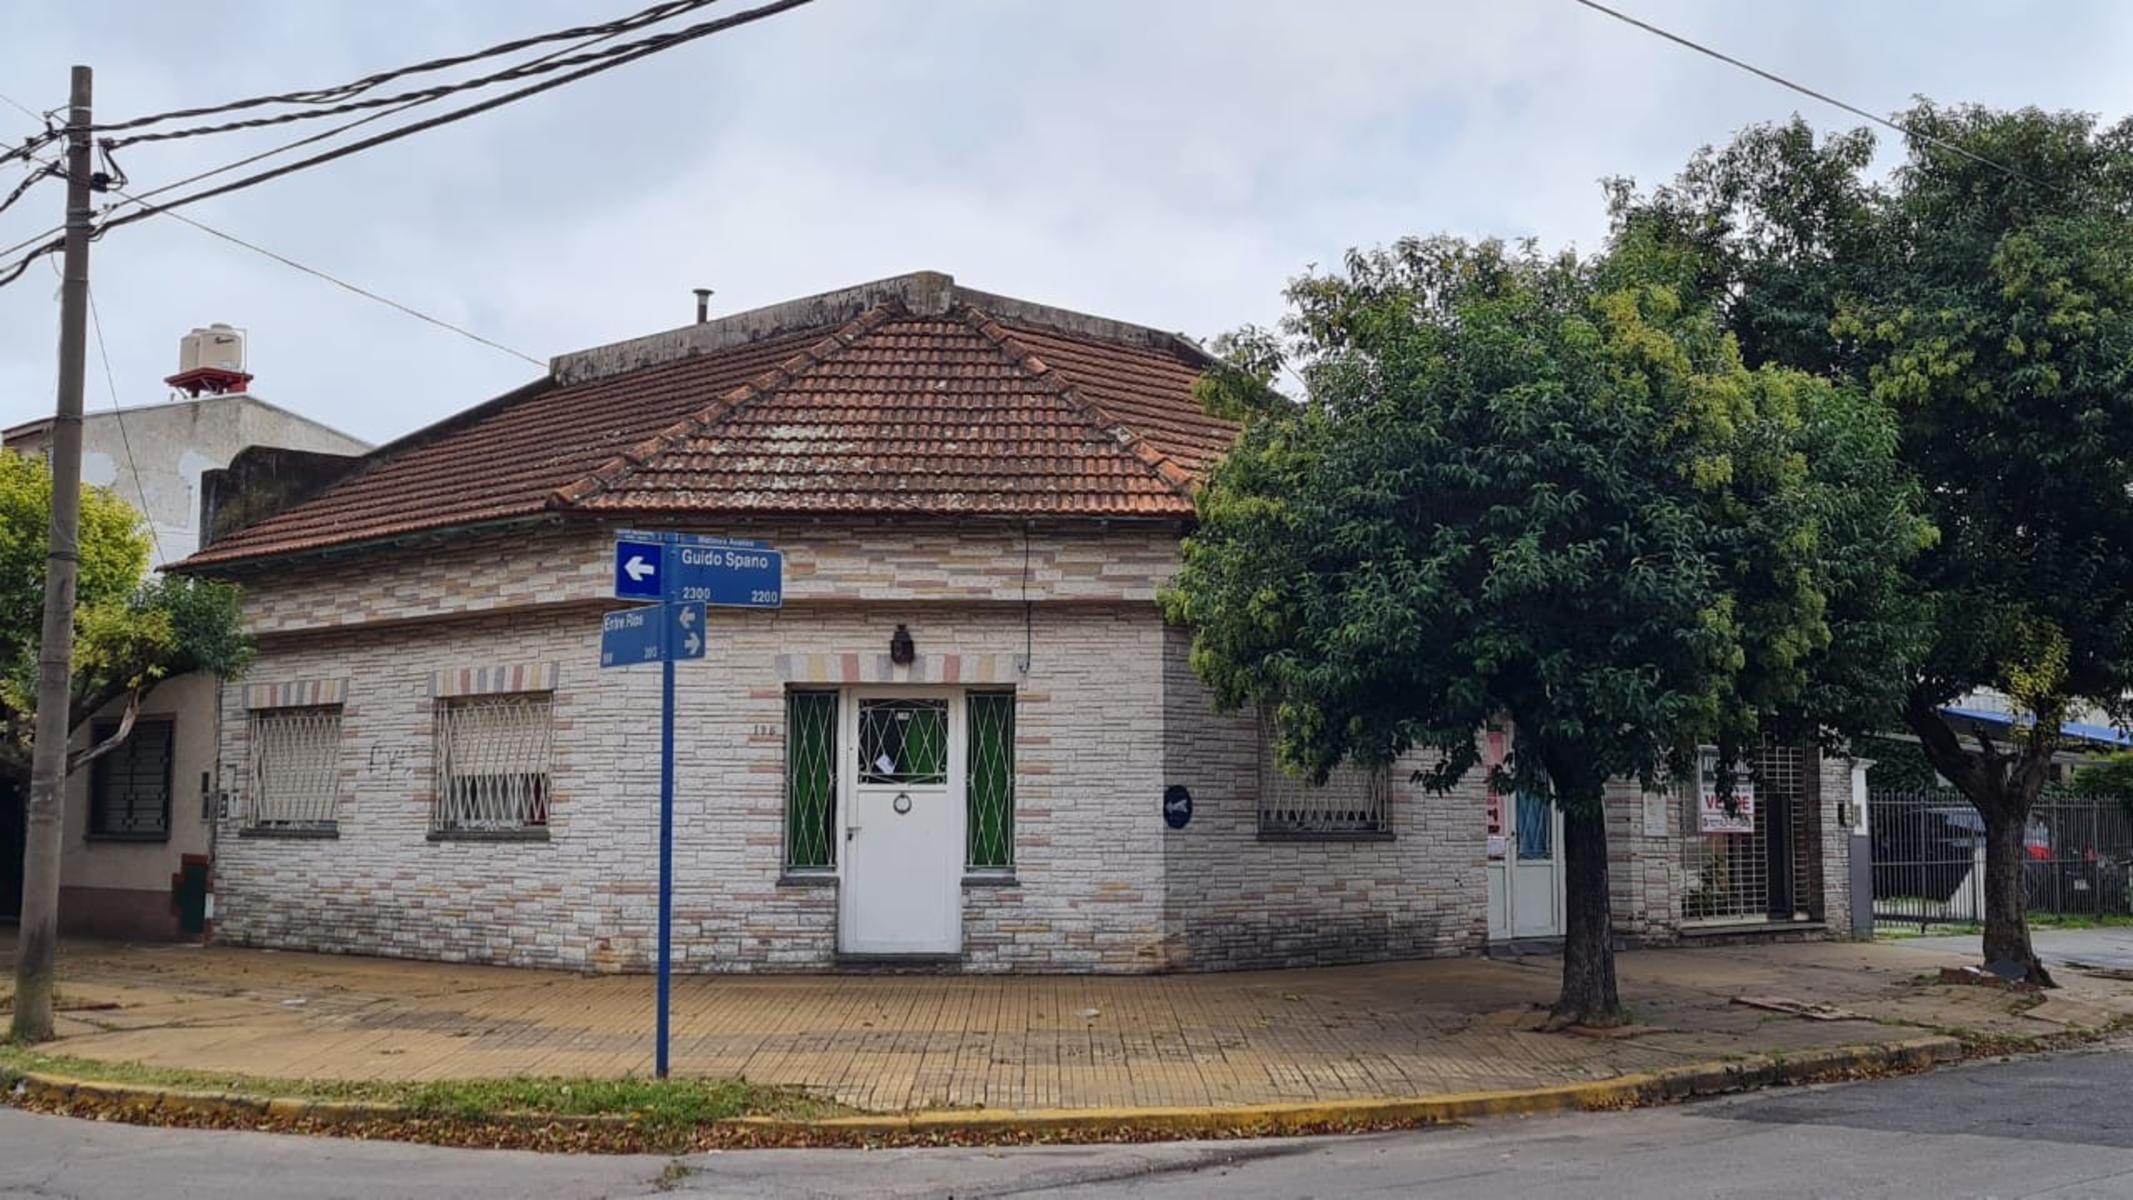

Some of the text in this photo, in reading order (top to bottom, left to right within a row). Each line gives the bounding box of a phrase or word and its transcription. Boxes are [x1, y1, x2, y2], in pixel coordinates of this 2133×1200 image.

[681, 549, 769, 569] Guido Spano
[682, 586, 778, 604] 2300 2200
